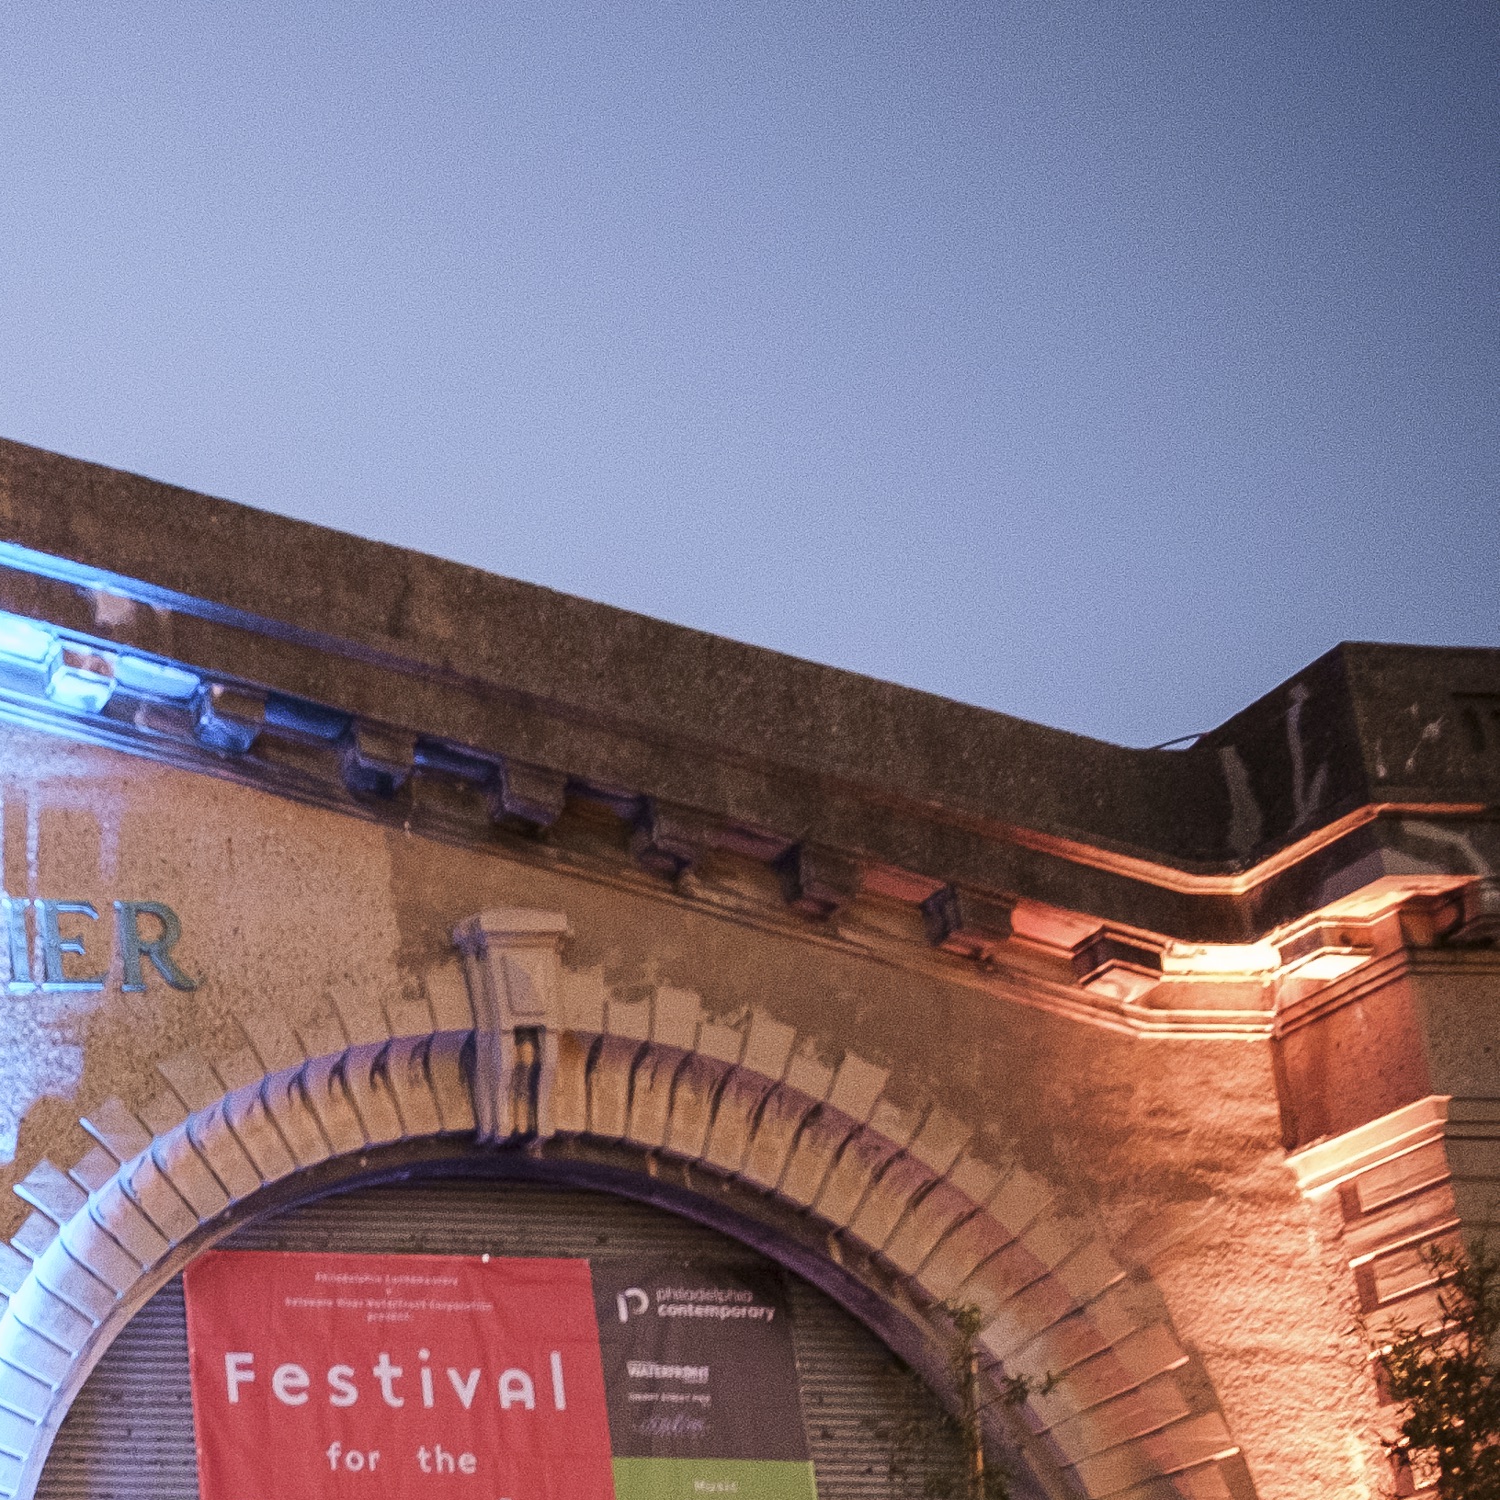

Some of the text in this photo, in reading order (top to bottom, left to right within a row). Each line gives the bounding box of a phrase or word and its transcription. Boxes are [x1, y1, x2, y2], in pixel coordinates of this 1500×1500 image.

[658, 1304, 775, 1322] contemporary
[326, 1441, 478, 1475] for the
[694, 1479, 737, 1493] Music
